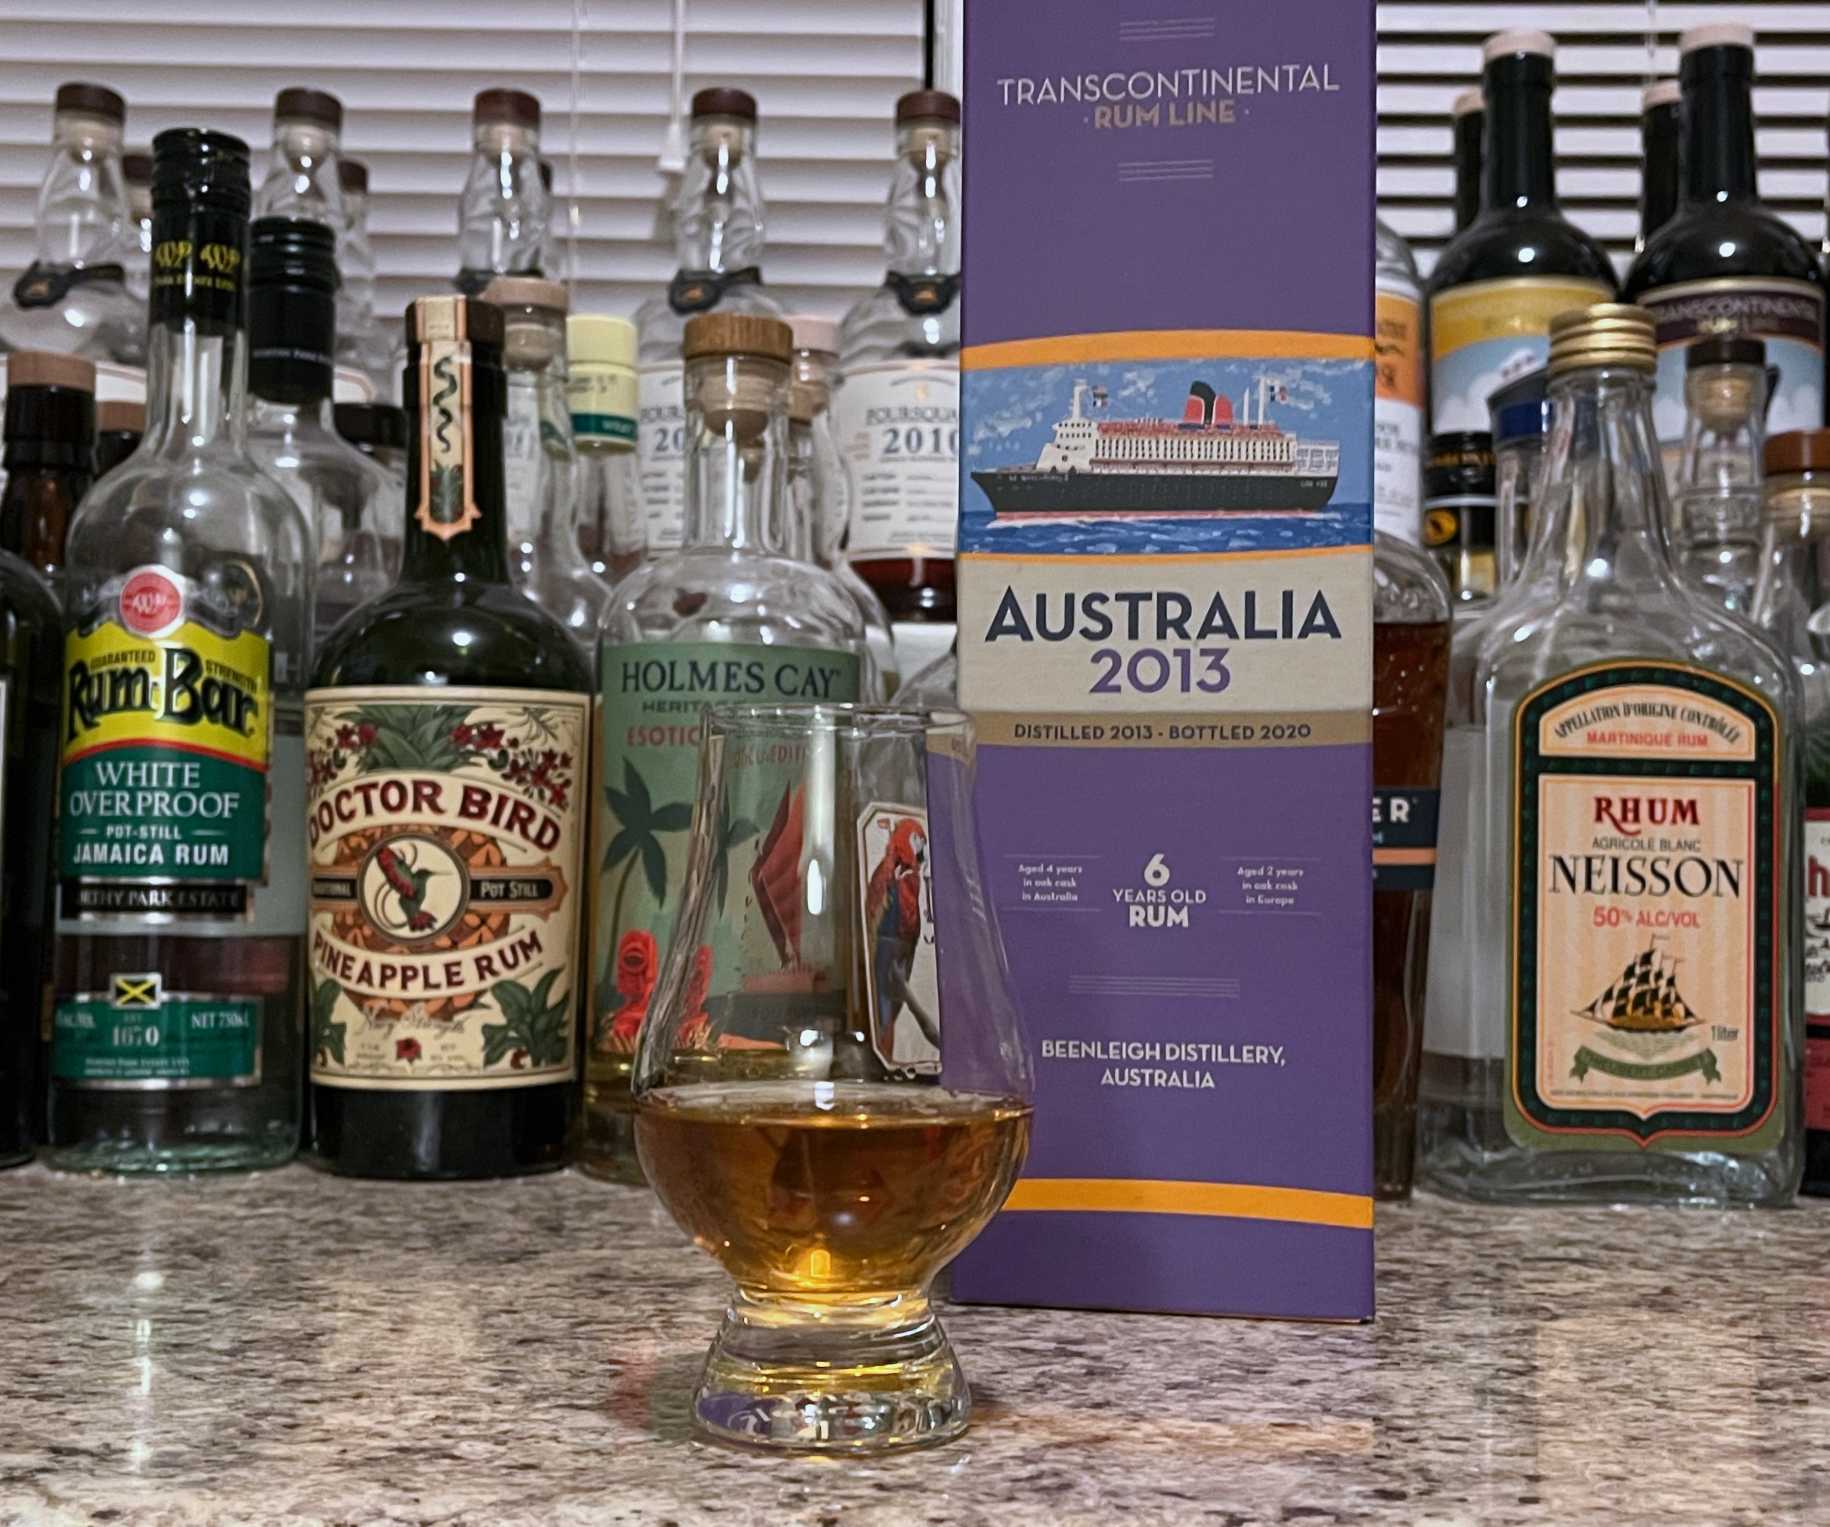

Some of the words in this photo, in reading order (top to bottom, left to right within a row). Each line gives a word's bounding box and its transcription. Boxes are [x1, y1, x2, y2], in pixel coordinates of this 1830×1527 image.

[997, 64, 1340, 106] TRANSCONTINENTAL
[1094, 103, 1160, 129] RUM
[1168, 99, 1236, 125] LINE
[985, 586, 1342, 642] AUSTRALIA
[621, 660, 765, 694] HOLMES
[774, 664, 836, 699] CAY
[1089, 647, 1231, 694] 2013
[1014, 723, 1104, 741] DISTILLED
[1110, 724, 1153, 741] 2013
[1169, 724, 1255, 741] BOTTLED
[1260, 723, 1312, 740] 2020
[1554, 704, 1621, 738] APPELLATION
[1623, 702, 1677, 719] D'ORIGINE
[626, 725, 700, 747] ESOTIC
[1586, 731, 1673, 747] MARTINIQUE
[1677, 733, 1709, 747] RUM
[96, 760, 201, 788] WHITE
[69, 791, 240, 818] OVERPROOF
[310, 780, 446, 849] DOCTOR
[457, 784, 561, 851] BIRD
[1593, 796, 1700, 836] RHUM
[73, 843, 165, 865] JAMAICA
[174, 843, 229, 866] RUM
[1592, 837, 1654, 851] AGRICOLE
[1659, 838, 1701, 852] BLANC
[1018, 864, 1044, 875] Aged
[1046, 864, 1053, 873] 4
[1056, 865, 1083, 875] years
[1143, 853, 1171, 887] 6
[1236, 866, 1265, 877] Aged
[1266, 866, 1274, 875] 2
[1276, 868, 1304, 878] years
[1549, 854, 1744, 899] NEISSON
[1023, 877, 1032, 887] in
[1241, 881, 1252, 890] in
[1022, 892, 1031, 901] in
[1033, 891, 1079, 901] Australia
[1112, 889, 1167, 903] YEARS
[1171, 889, 1207, 903] OLD
[1246, 895, 1256, 904] in
[1257, 895, 1295, 907] Europe
[1129, 904, 1189, 928] RUM
[1636, 909, 1701, 929] ALC/VOL
[313, 929, 465, 991] PINEAPPLE
[474, 930, 543, 980] RUM
[1041, 1039, 1161, 1061] BEENLEIGH
[1165, 1043, 1286, 1066] DISTILLERY,
[1100, 1068, 1216, 1089] AUSTRALIA
